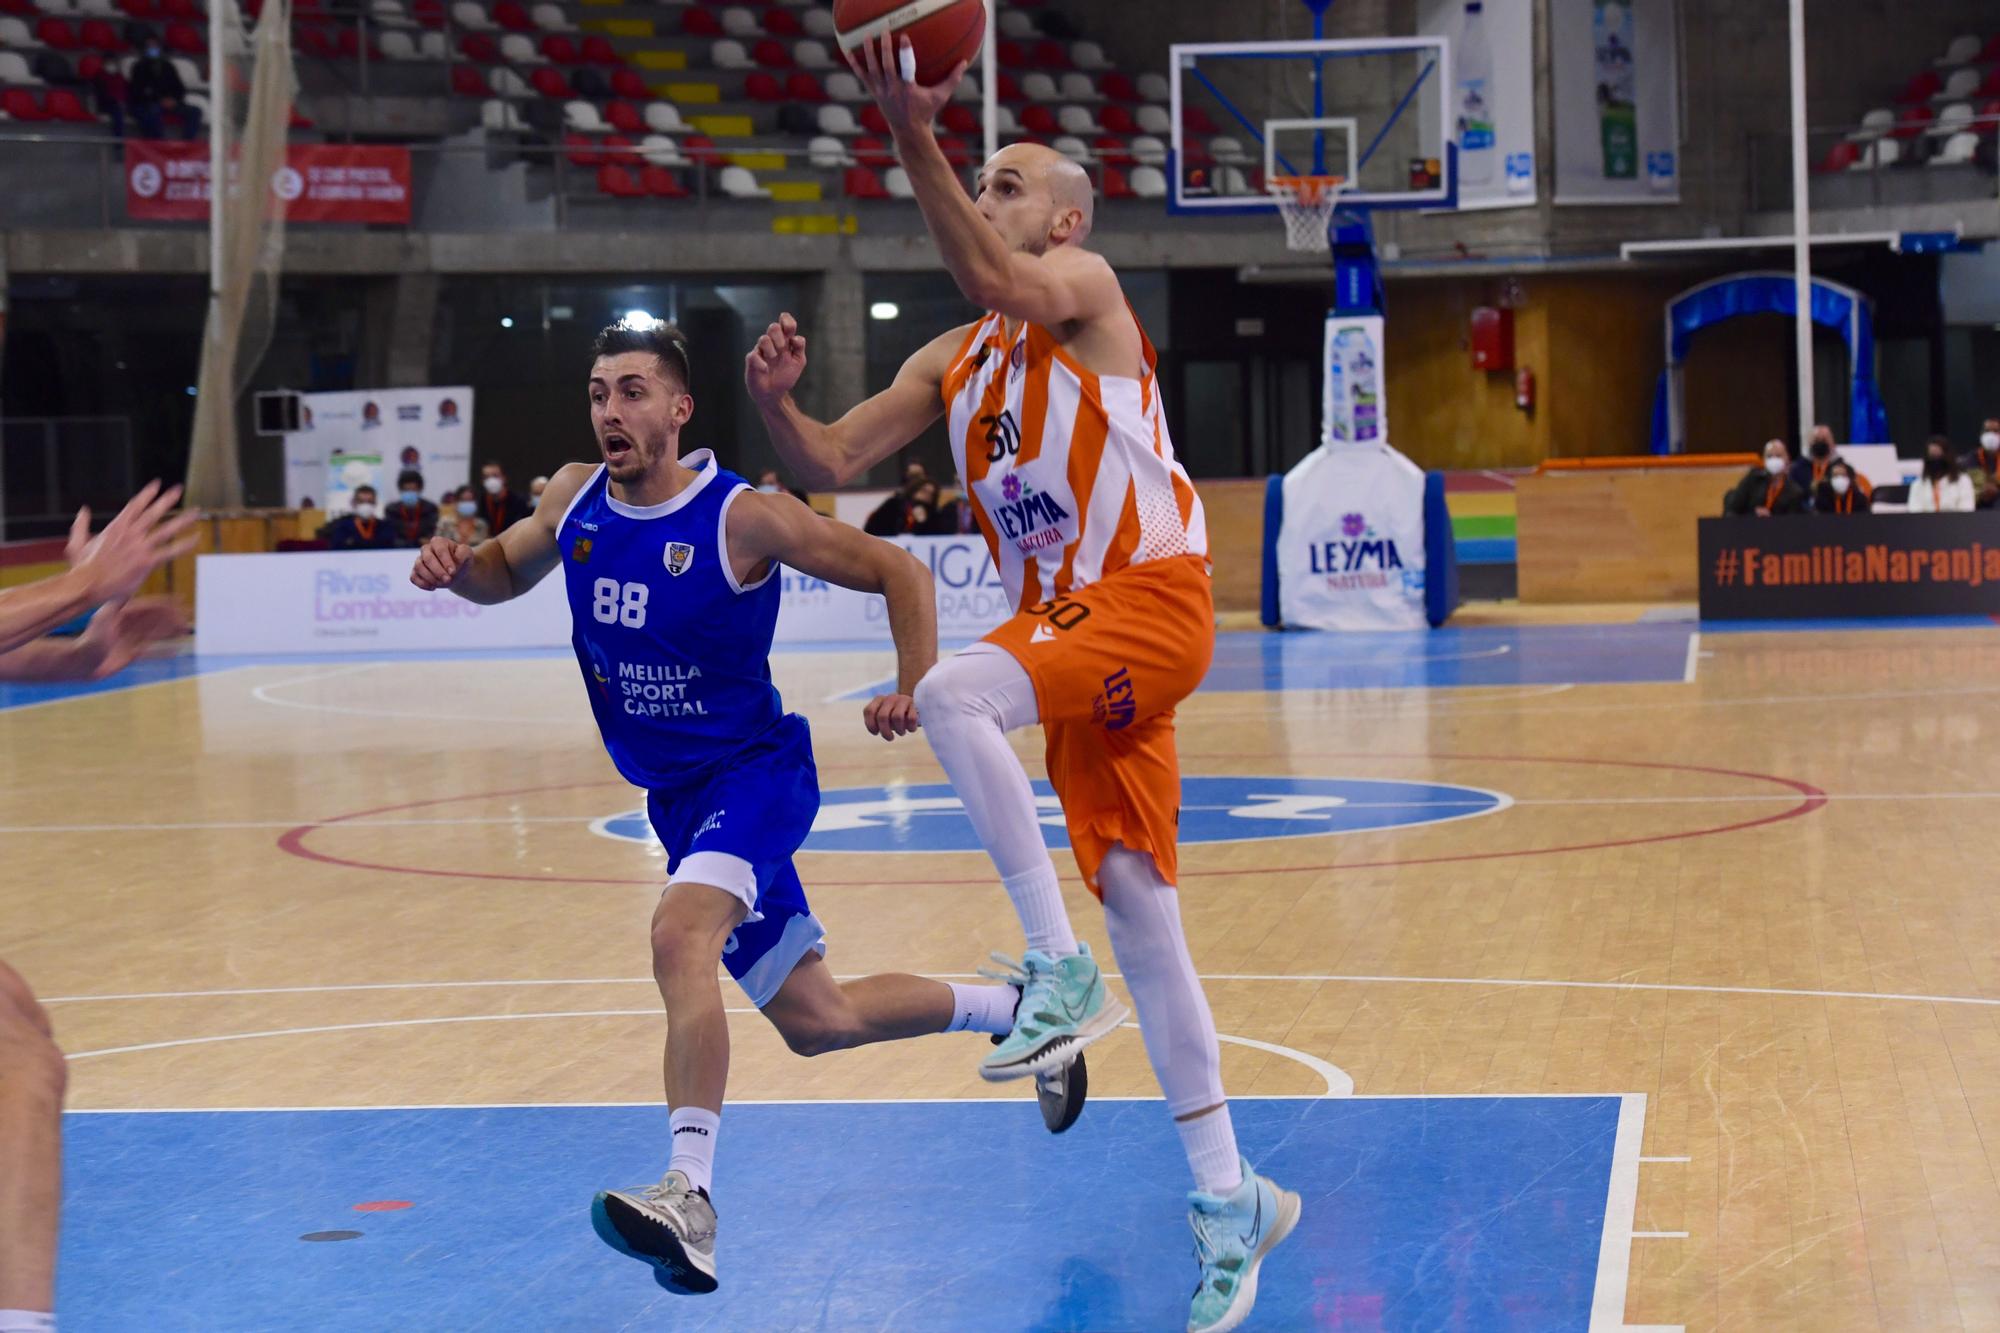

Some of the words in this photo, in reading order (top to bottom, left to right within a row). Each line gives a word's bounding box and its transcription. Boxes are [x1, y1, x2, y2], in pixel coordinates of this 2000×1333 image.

[979, 409, 1022, 463] 30
[993, 490, 1070, 540] LEYMA
[1310, 537, 1404, 575] LEYMA
[1714, 542, 2000, 586] #FamiliaNaranja
[315, 570, 390, 595] Rivas
[315, 595, 484, 622] Lombardero
[593, 577, 650, 629] 88
[618, 661, 702, 682] MELILLA
[621, 681, 688, 701] SPORT
[623, 698, 709, 718] CAPITAL
